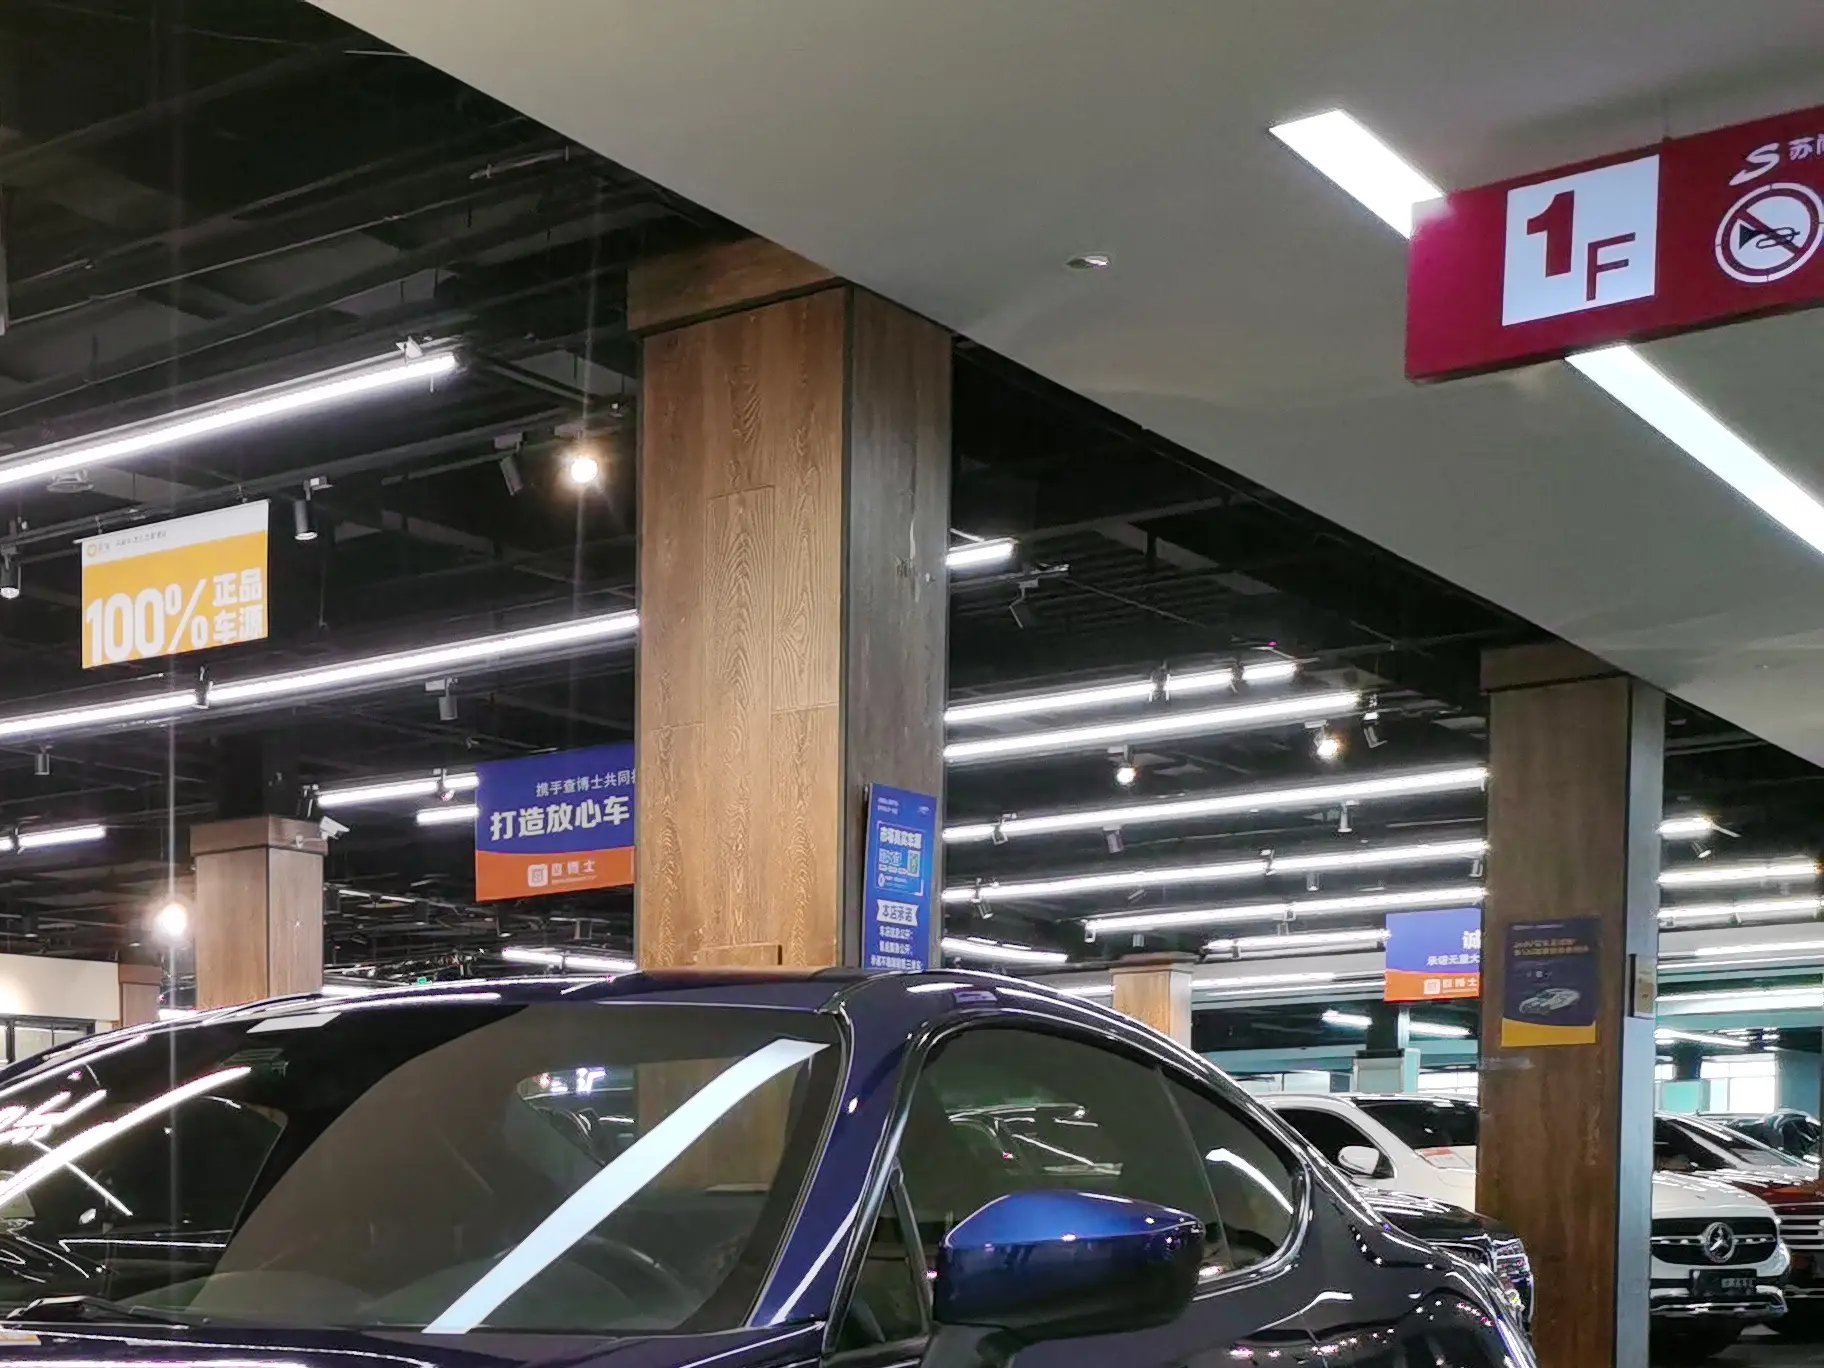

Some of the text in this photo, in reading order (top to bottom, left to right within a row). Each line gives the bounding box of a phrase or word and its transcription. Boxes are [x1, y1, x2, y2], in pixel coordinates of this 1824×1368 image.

[1527, 190, 1636, 301] 1F
[213, 567, 263, 607] 正品
[86, 578, 209, 667] 100%
[213, 604, 264, 644] 车源
[490, 795, 630, 842] 打造放心车
